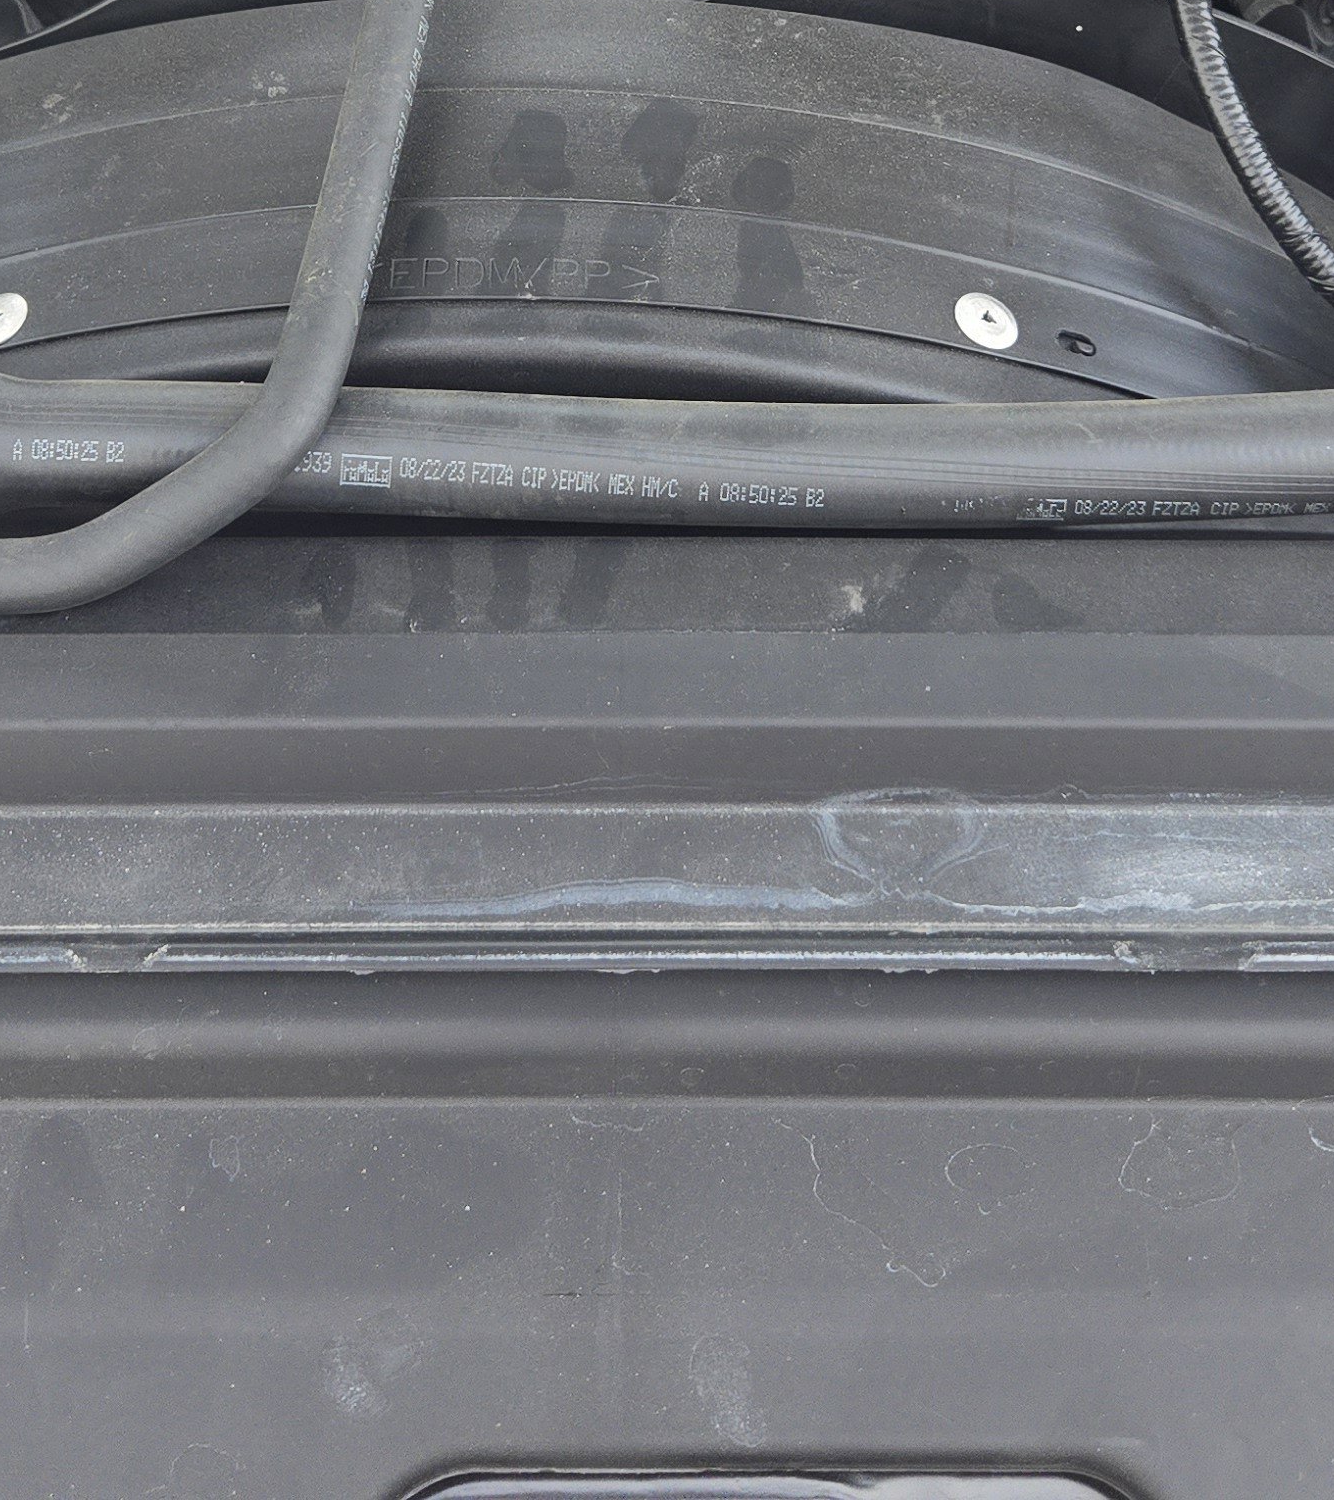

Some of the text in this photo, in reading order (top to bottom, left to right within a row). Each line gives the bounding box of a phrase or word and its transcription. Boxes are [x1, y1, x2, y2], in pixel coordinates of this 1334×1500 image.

[31, 438, 99, 462] 08:50:25
[399, 457, 466, 482] 08/22/23
[522, 466, 547, 489] CIP
[608, 473, 634, 496] MEX
[698, 481, 709, 502] A
[720, 482, 798, 506] 08:50:25
[1075, 500, 1146, 516] 08/22/23
[1210, 501, 1240, 516] CIP
